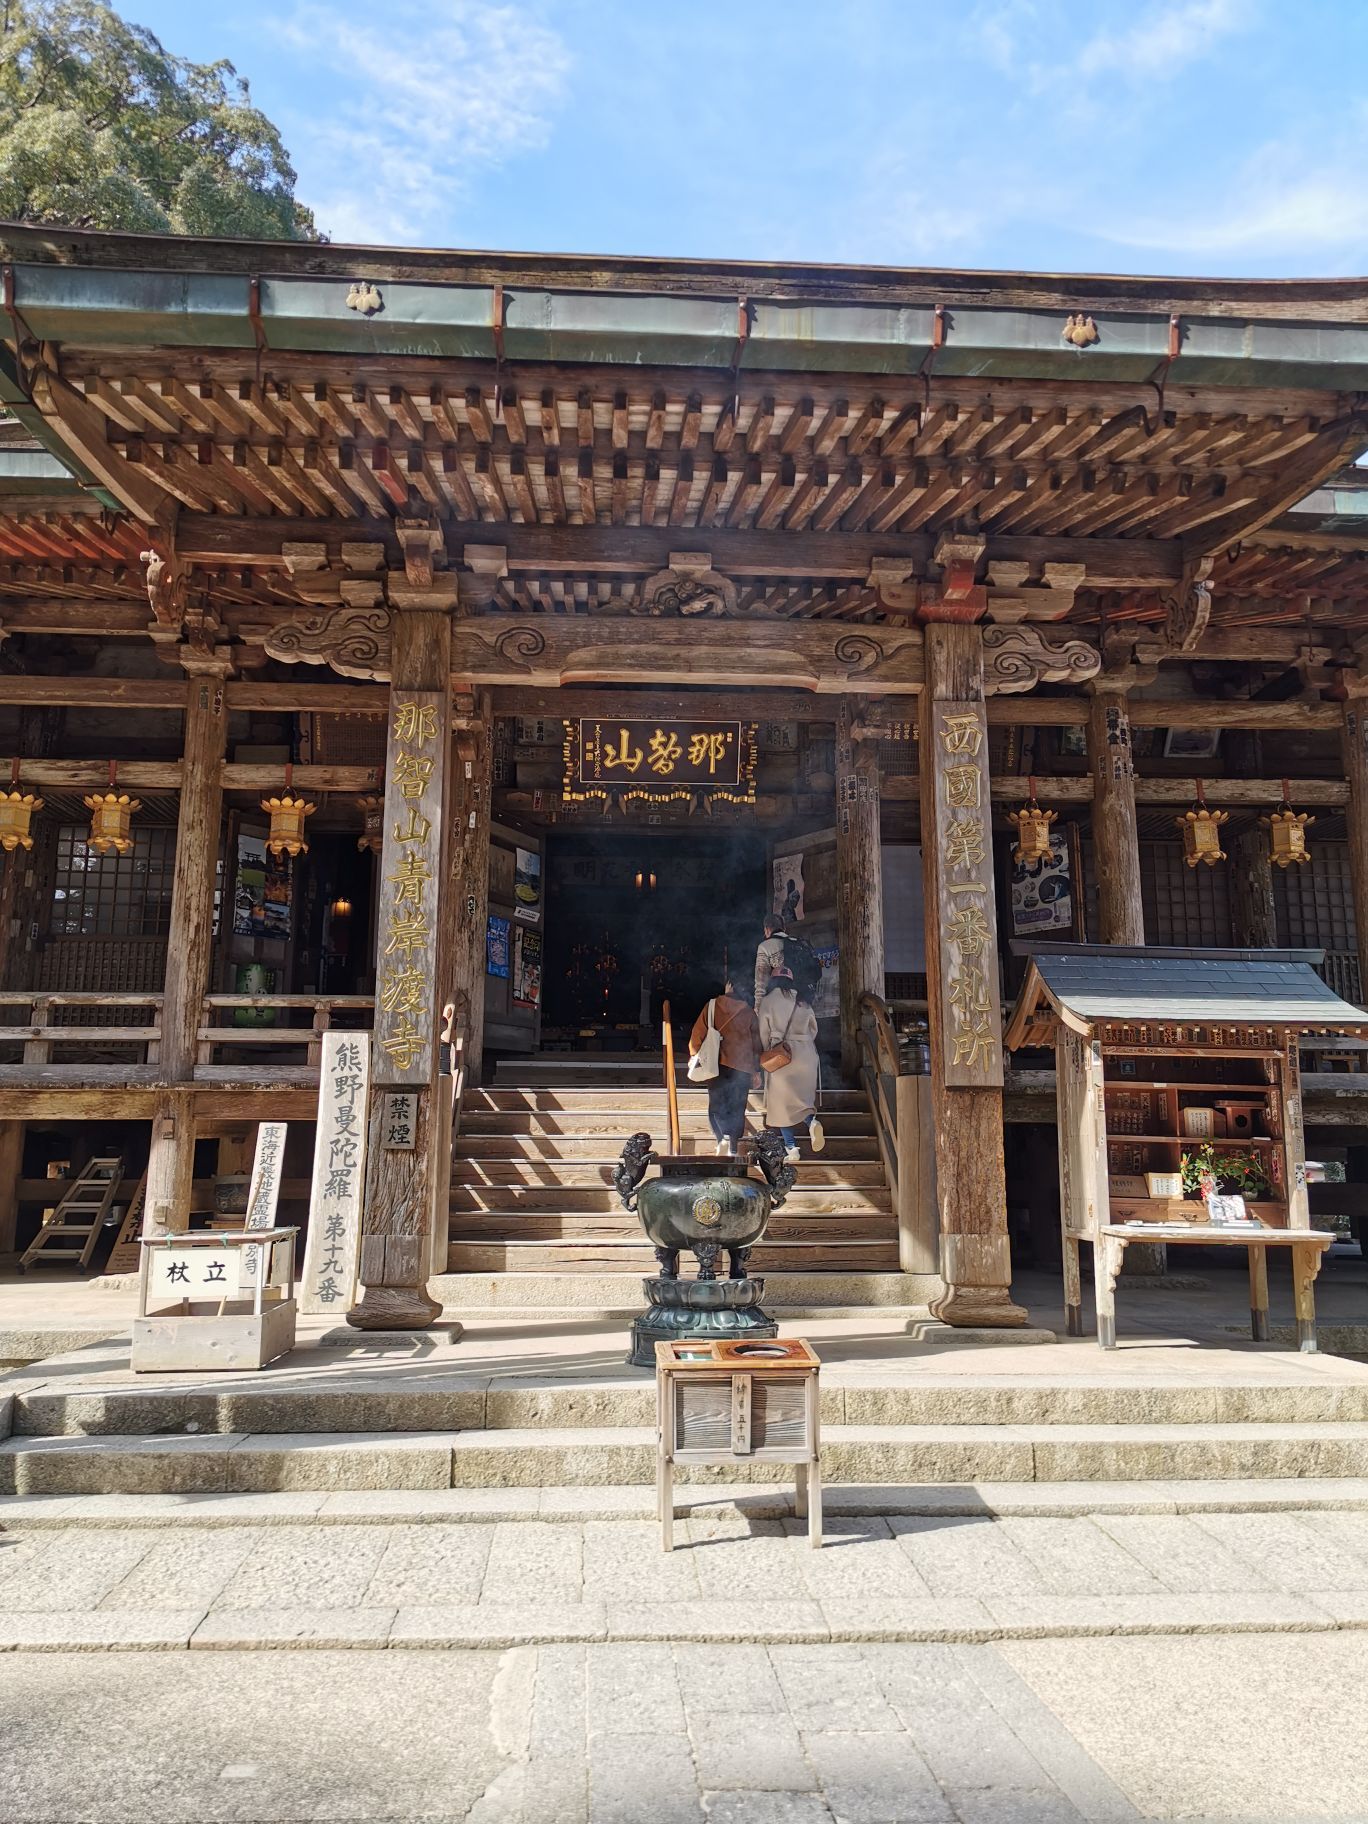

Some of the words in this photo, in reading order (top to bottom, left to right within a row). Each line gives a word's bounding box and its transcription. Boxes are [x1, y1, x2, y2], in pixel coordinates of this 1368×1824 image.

[380, 700, 439, 1071] 那智山青岸渡寺
[939, 712, 997, 1073] 西國第一番札所
[323, 1041, 364, 1200] 熊野曼陀羅
[387, 1096, 411, 1145] 禁煙
[165, 1260, 228, 1284] 杖立
